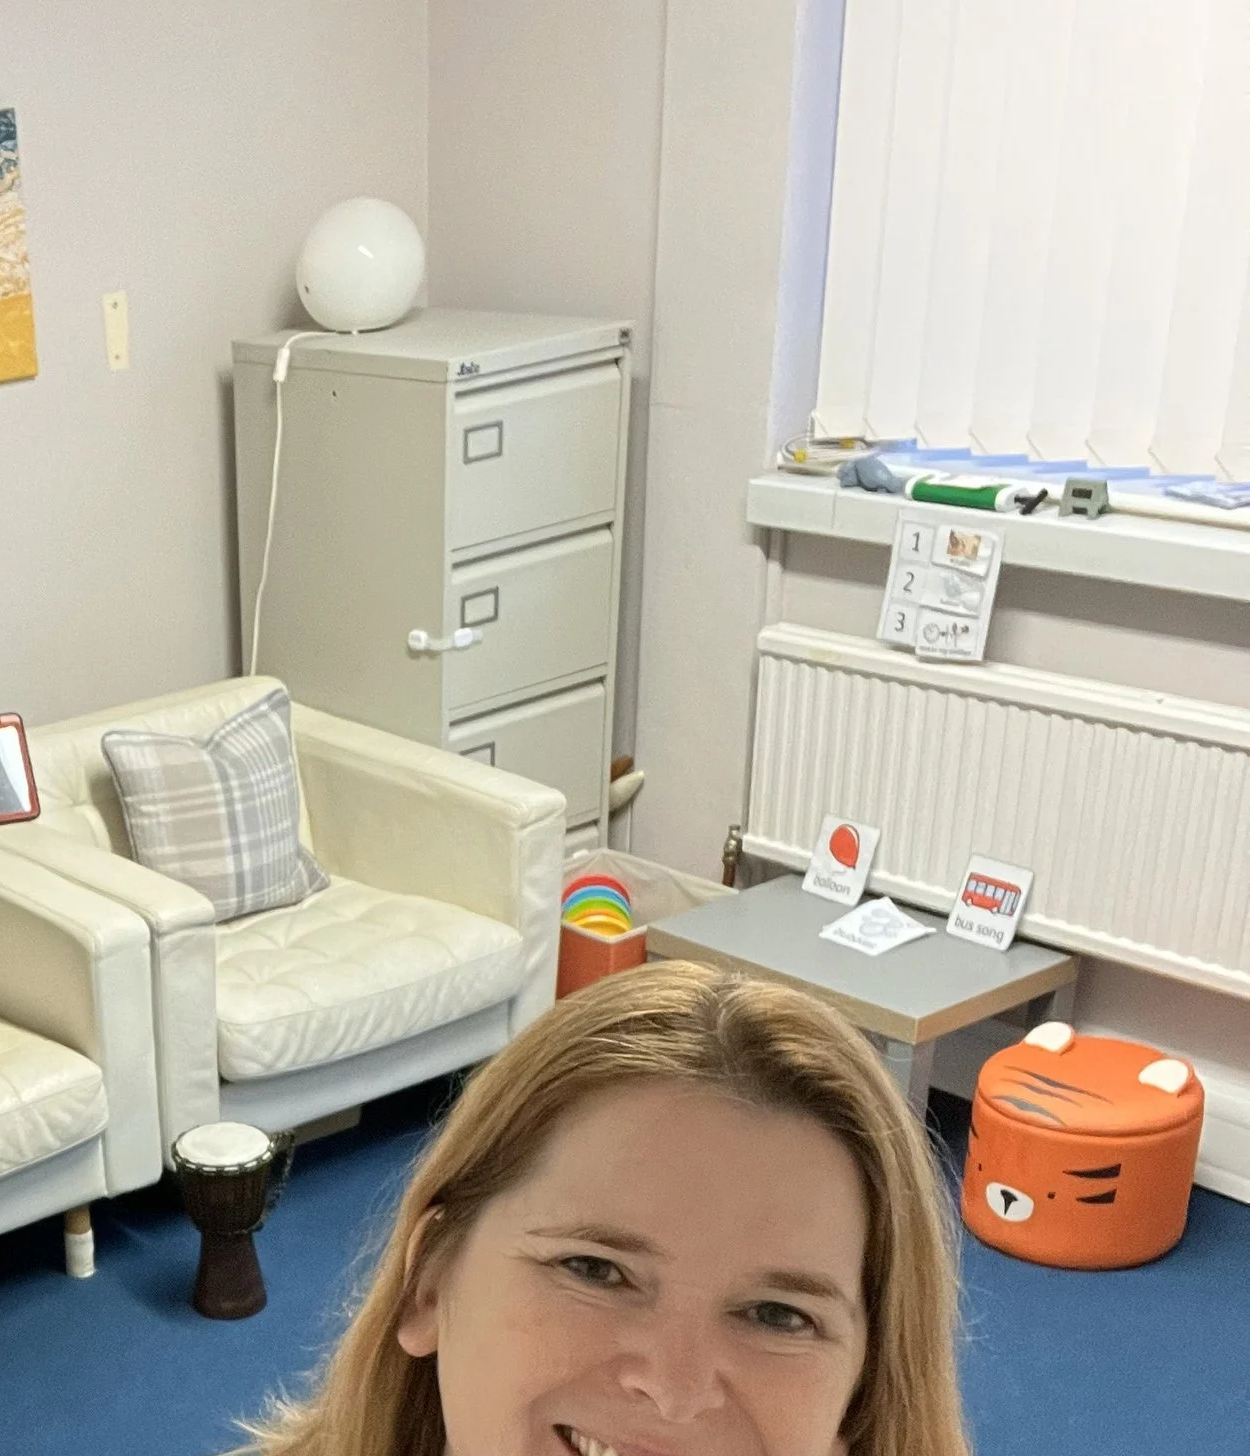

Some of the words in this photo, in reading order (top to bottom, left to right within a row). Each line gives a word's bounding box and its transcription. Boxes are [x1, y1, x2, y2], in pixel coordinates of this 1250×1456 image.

[911, 531, 920, 553] 1
[903, 571, 915, 593] 2
[894, 611, 906, 633] 3
[813, 873, 851, 897] balloon
[954, 914, 975, 931] bus
[976, 923, 1004, 945] song
